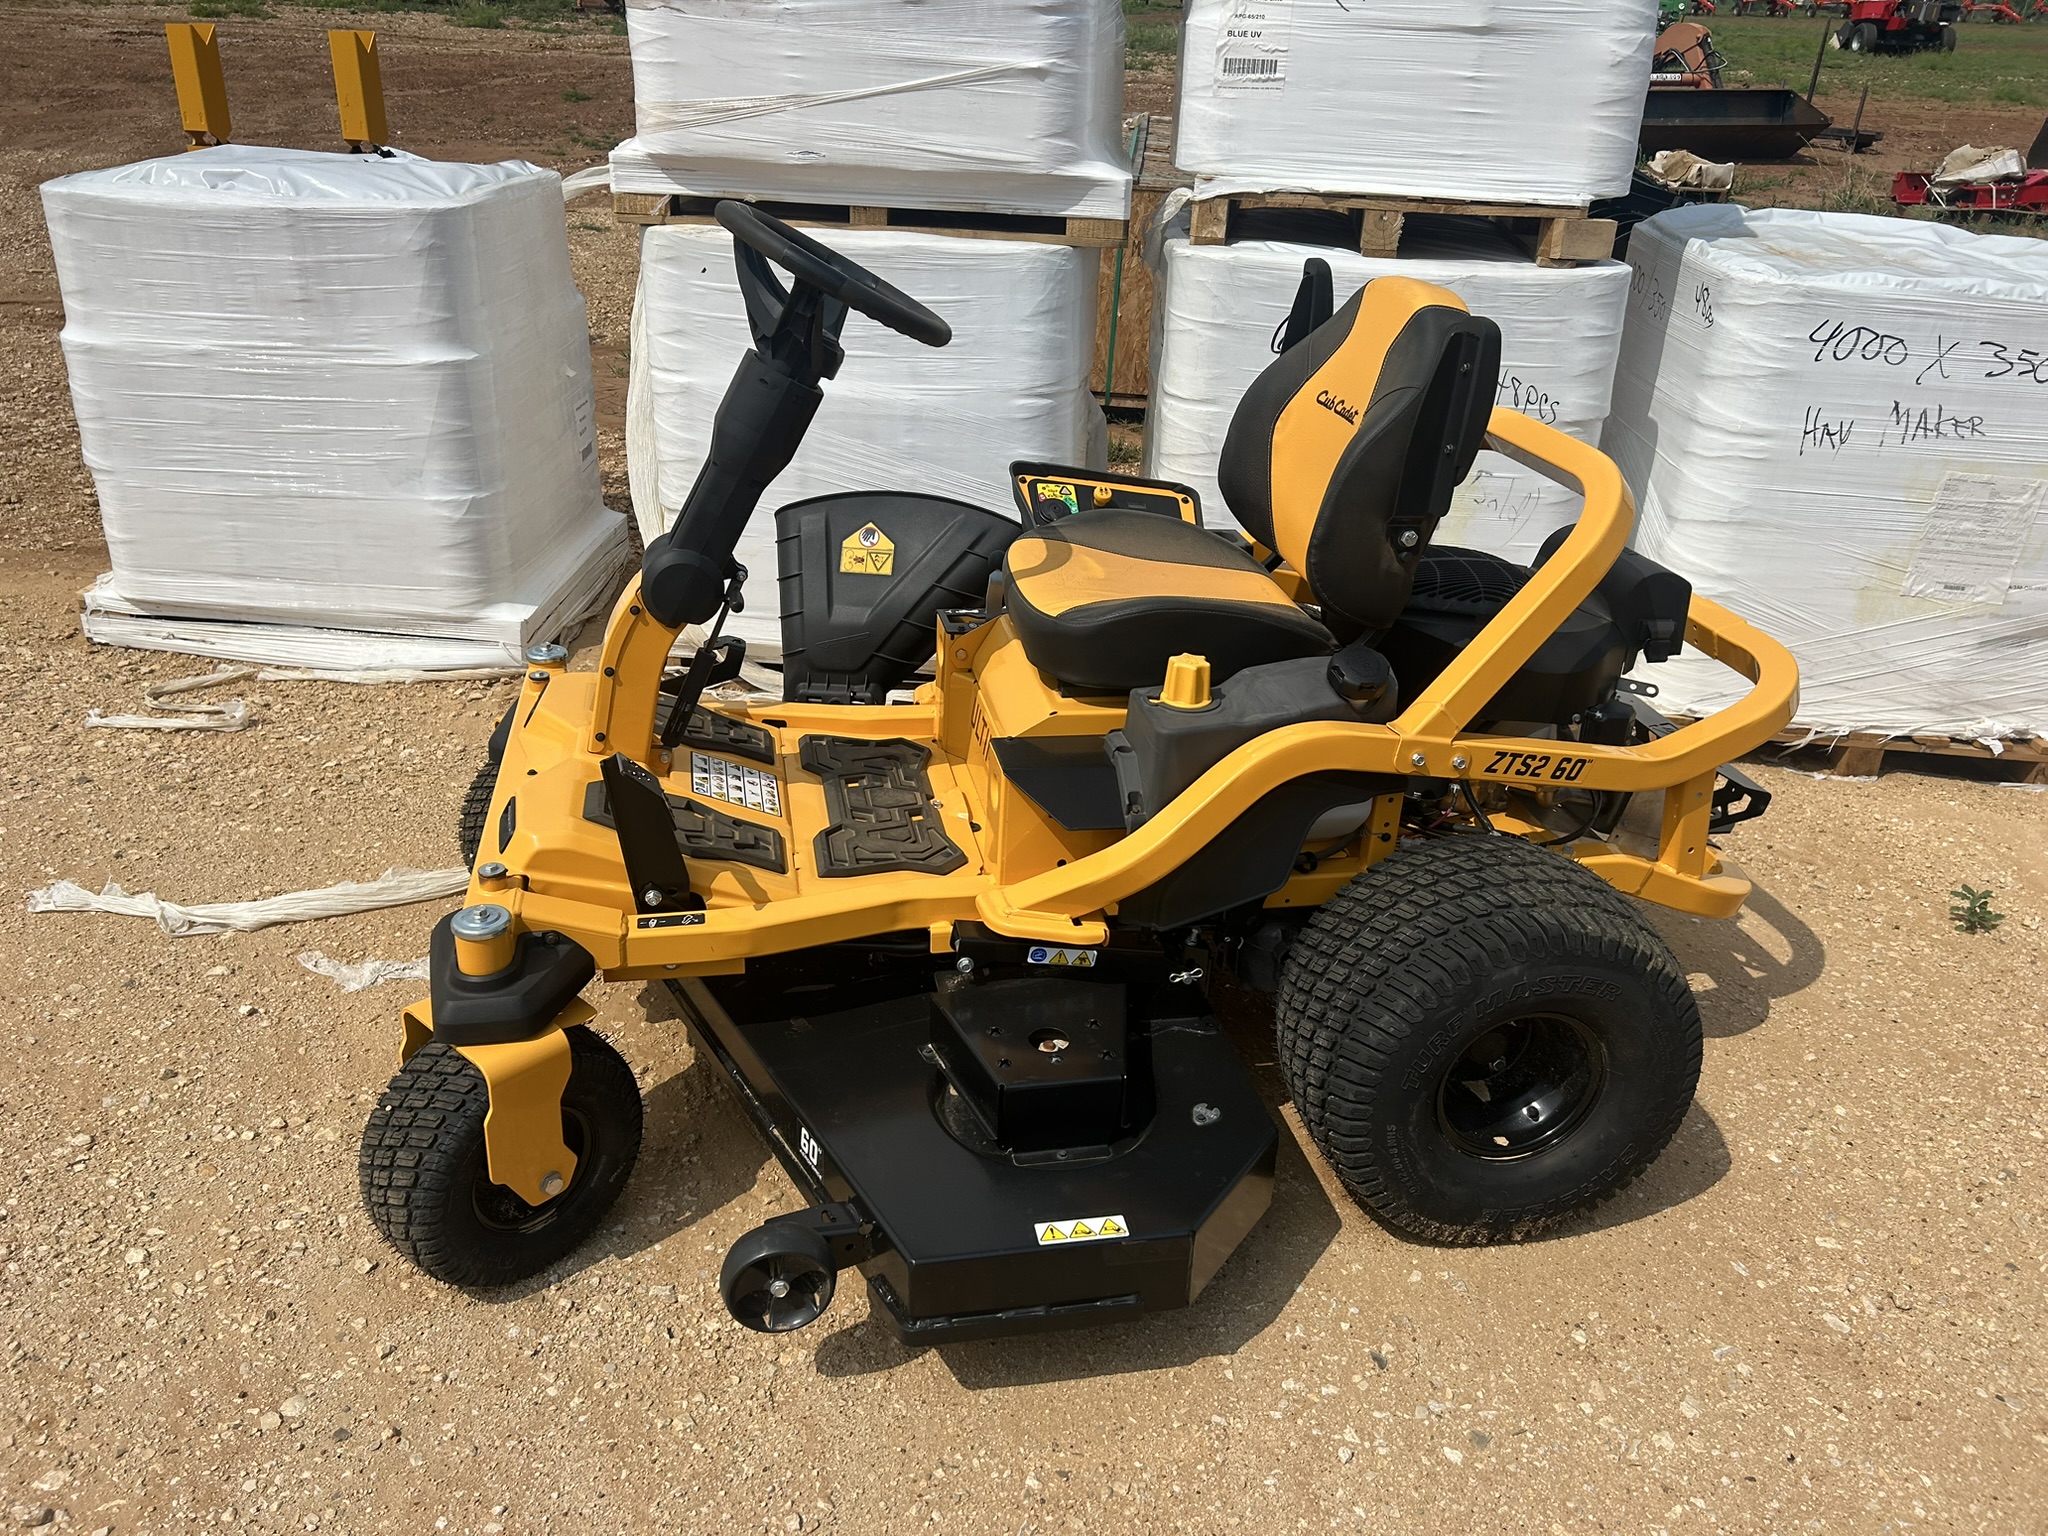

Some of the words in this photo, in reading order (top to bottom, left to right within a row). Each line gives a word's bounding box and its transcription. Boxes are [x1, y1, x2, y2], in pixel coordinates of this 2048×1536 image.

[1226, 29, 1249, 38] BLUE
[1250, 31, 1263, 39] UV
[1808, 318, 1909, 366] 4000
[1316, 389, 1337, 411] Cub
[1333, 399, 1359, 426] Cadet
[1878, 399, 1987, 457] MAKER
[1483, 751, 1551, 778] ZTS2
[1550, 757, 1594, 781] 60"
[1401, 1013, 1466, 1092] TURF
[1473, 973, 1624, 1020] MASTER
